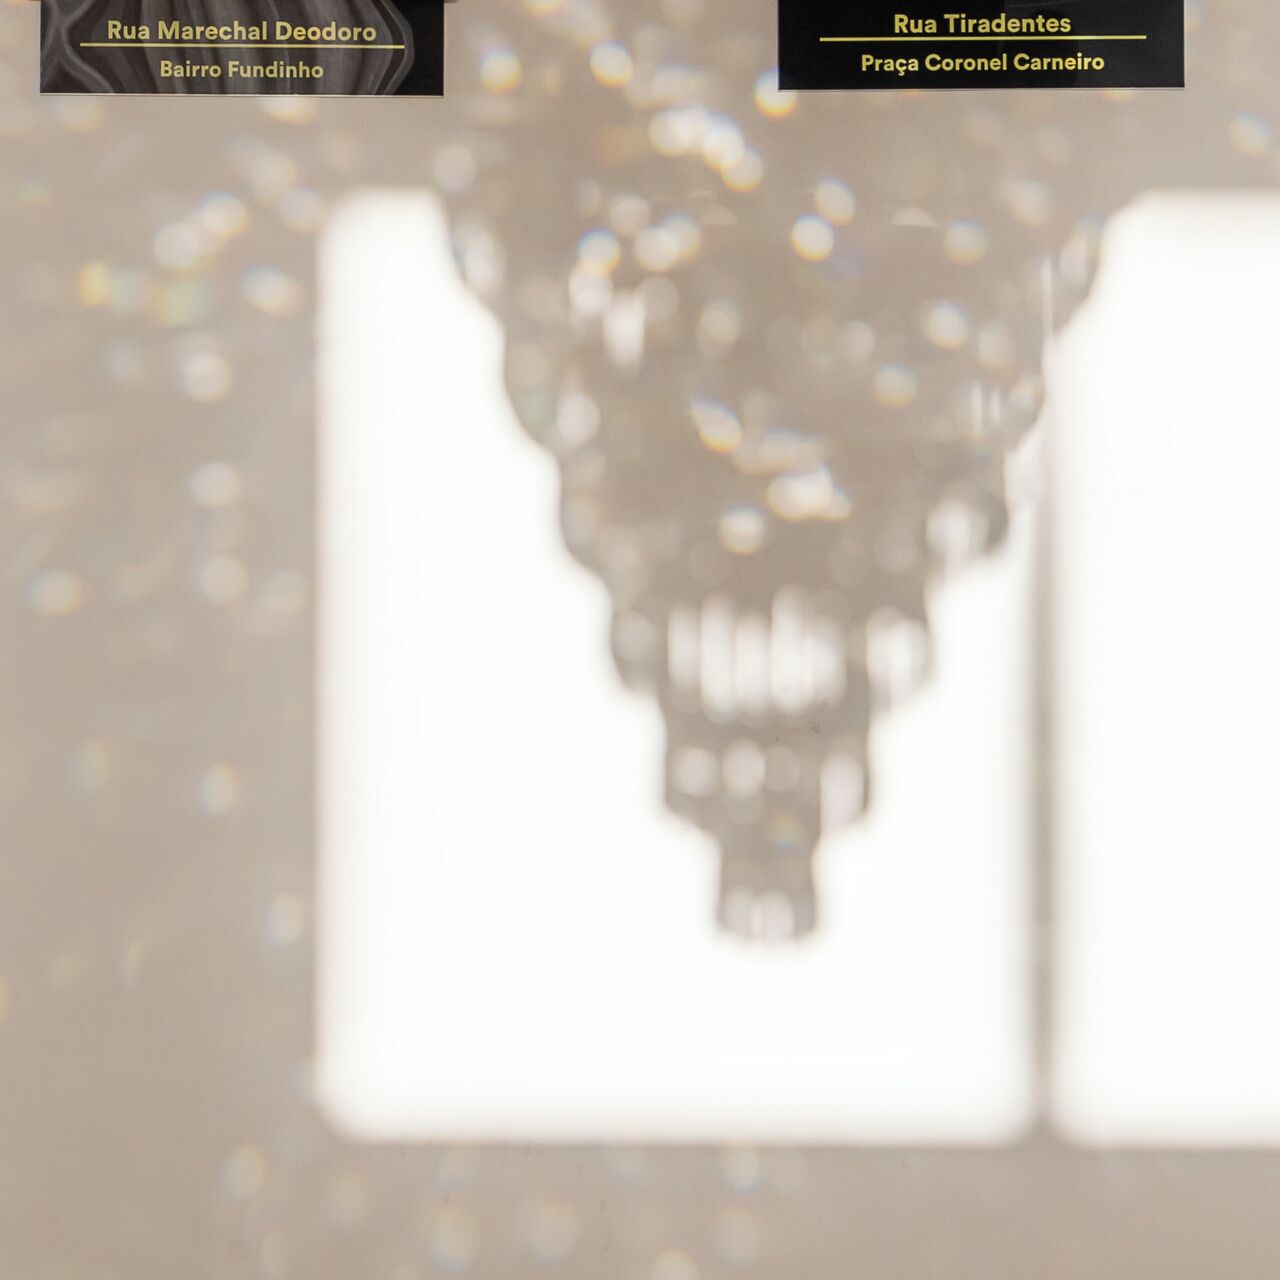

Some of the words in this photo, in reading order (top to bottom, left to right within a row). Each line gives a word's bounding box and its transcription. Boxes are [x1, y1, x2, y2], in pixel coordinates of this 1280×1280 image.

[107, 19, 150, 40] Rua
[157, 19, 267, 41] Marechal
[275, 21, 377, 42] Deodoro
[894, 13, 937, 33] Rua
[943, 12, 1072, 33] Tiradentes
[159, 60, 222, 78] Bairro
[228, 60, 324, 79] Fundinho
[861, 54, 919, 77] Praça
[924, 52, 1008, 72] Coronel
[1013, 52, 1105, 71] Carneiro
